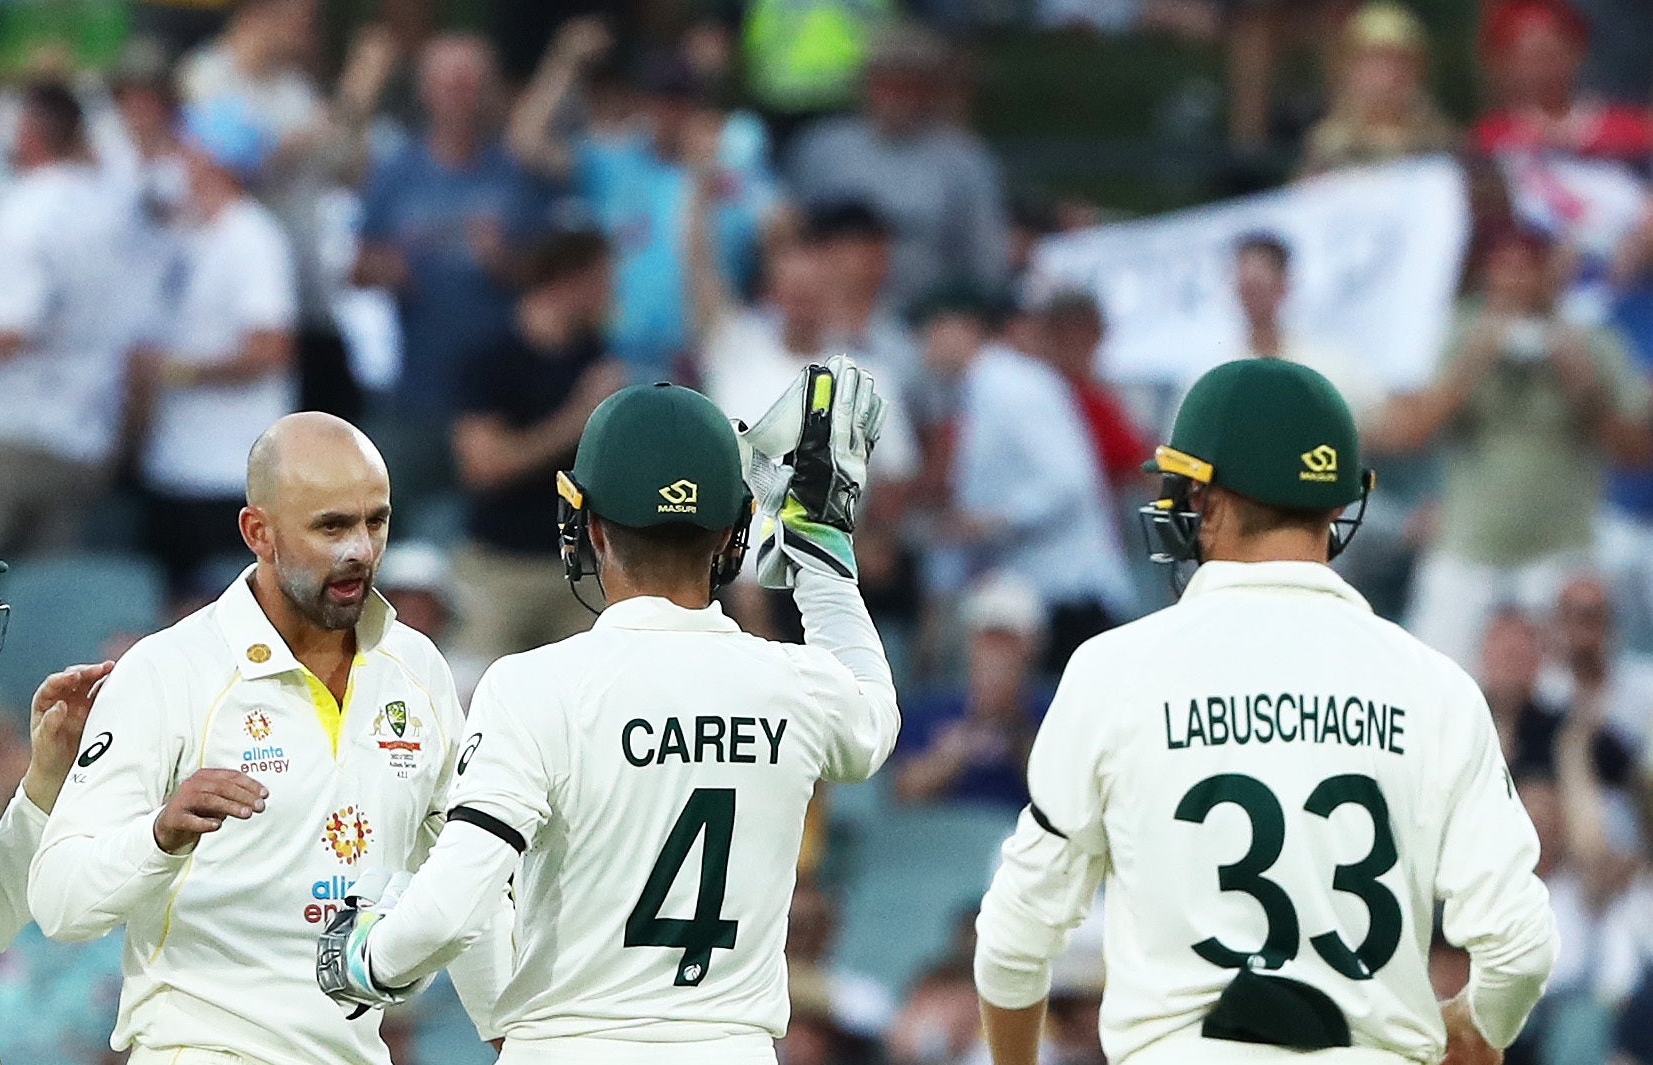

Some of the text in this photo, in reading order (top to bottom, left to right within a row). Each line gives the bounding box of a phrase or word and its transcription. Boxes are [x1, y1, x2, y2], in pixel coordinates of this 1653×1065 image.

[658, 504, 697, 514] MASURI
[621, 715, 788, 767] CAREY
[1164, 693, 1406, 756] LABUSCHAGNE
[240, 759, 290, 773] energy
[243, 746, 284, 761] alinta
[624, 787, 739, 987] 4
[1175, 773, 1403, 980] 33
